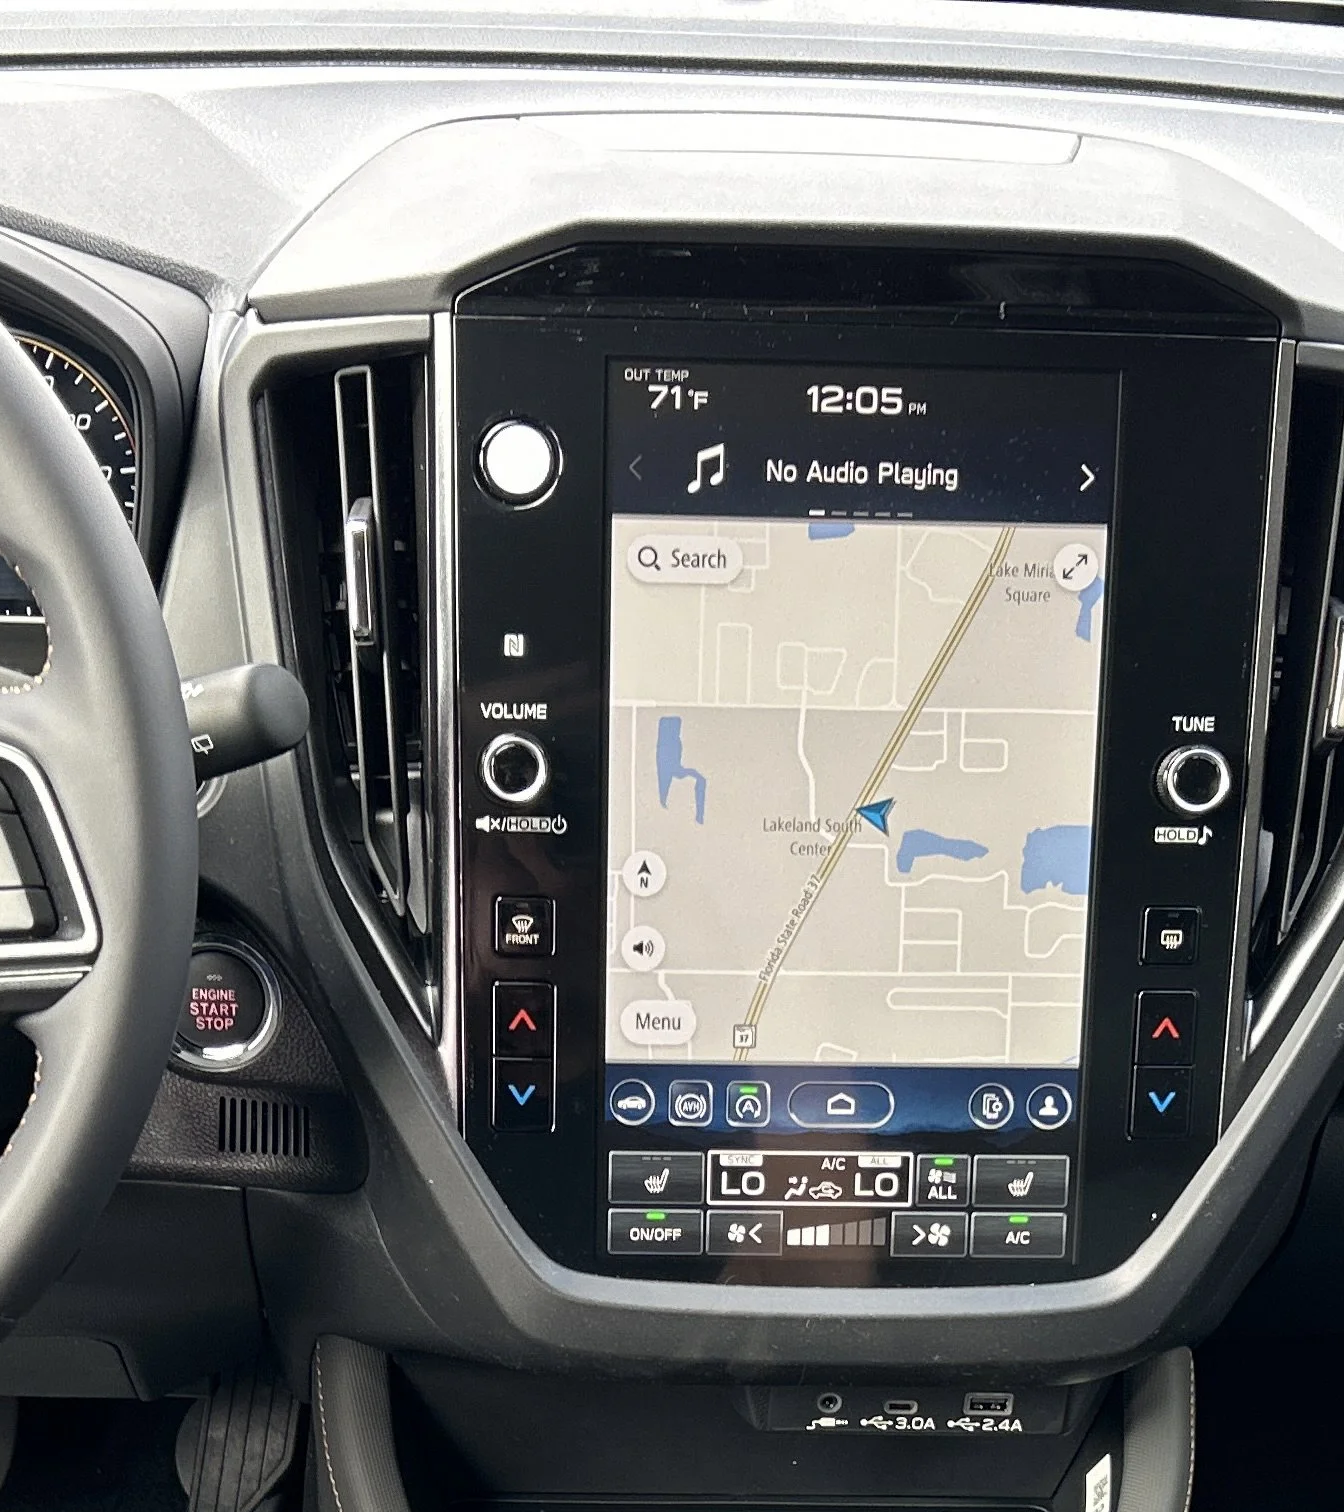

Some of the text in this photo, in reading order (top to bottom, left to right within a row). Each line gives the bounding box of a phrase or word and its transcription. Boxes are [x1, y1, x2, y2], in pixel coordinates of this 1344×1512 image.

[624, 368, 689, 382] OUT TEMP
[648, 384, 709, 411] 71°F
[806, 385, 927, 416] 12:05 PM
[766, 459, 959, 491] No Audio Playing
[669, 547, 728, 571] Search
[989, 562, 1019, 578] Lake
[1005, 587, 1051, 606] Square
[480, 702, 547, 720] VOLUME
[1171, 716, 1215, 732] TUNE
[508, 817, 551, 832] HOLD
[763, 816, 863, 833] Lakeland South
[1156, 826, 1197, 843] HOLD
[789, 841, 832, 857] Center
[758, 873, 822, 983] Florida State Road 37
[505, 933, 540, 946] FRONT
[192, 988, 236, 1002] ENGINE
[189, 1002, 239, 1017] START
[195, 1017, 235, 1031] STOP
[635, 1012, 682, 1031] Menu
[726, 1154, 755, 1165] SYNC
[821, 1157, 846, 1172] A/C
[870, 1155, 889, 1166] ALL
[720, 1171, 765, 1197] LO
[854, 1172, 899, 1198] LO
[927, 1186, 957, 1200] ALL
[629, 1227, 682, 1242] ON/OFF
[1005, 1230, 1031, 1245] A/C
[894, 1416, 936, 1432] 3.0A
[981, 1417, 1023, 1433] 2.4A
